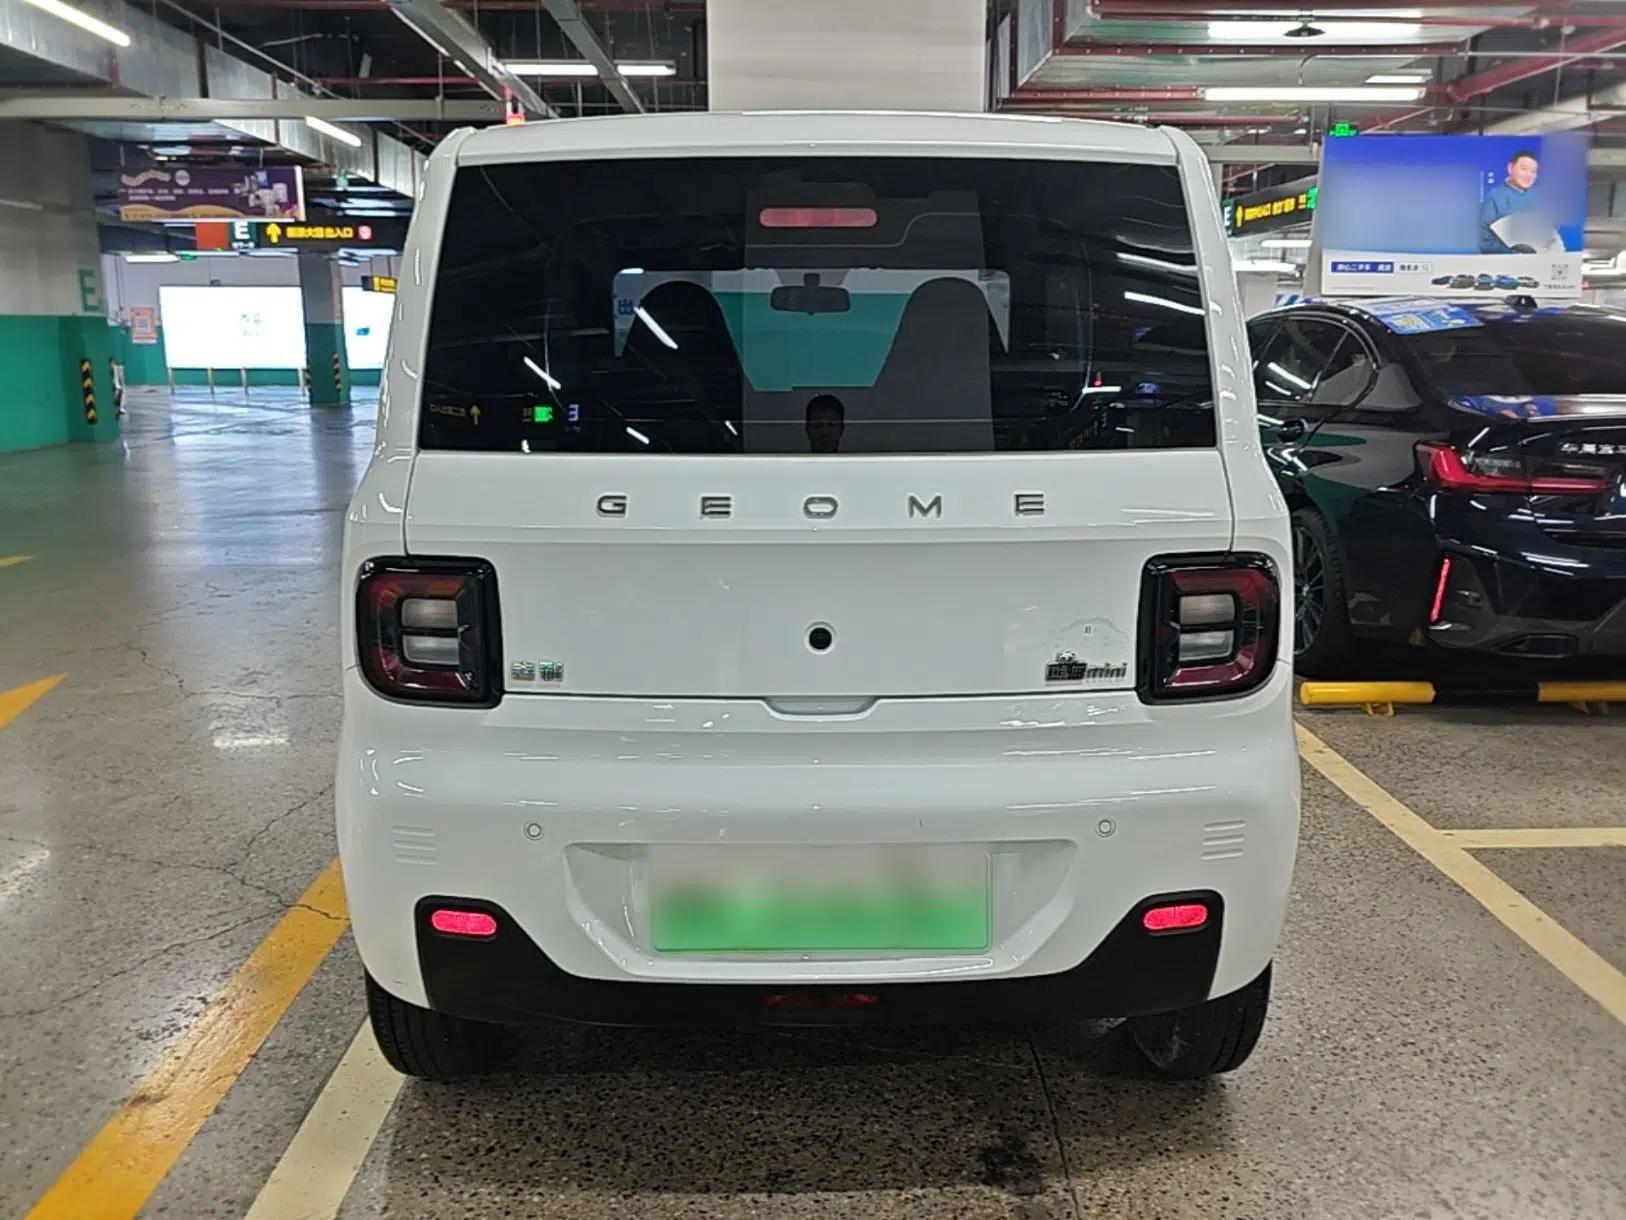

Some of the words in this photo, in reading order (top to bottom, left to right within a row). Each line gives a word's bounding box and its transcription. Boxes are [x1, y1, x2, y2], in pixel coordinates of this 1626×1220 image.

[235, 220, 250, 239] E
[78, 269, 99, 312] E
[597, 494, 1045, 518] GEOME
